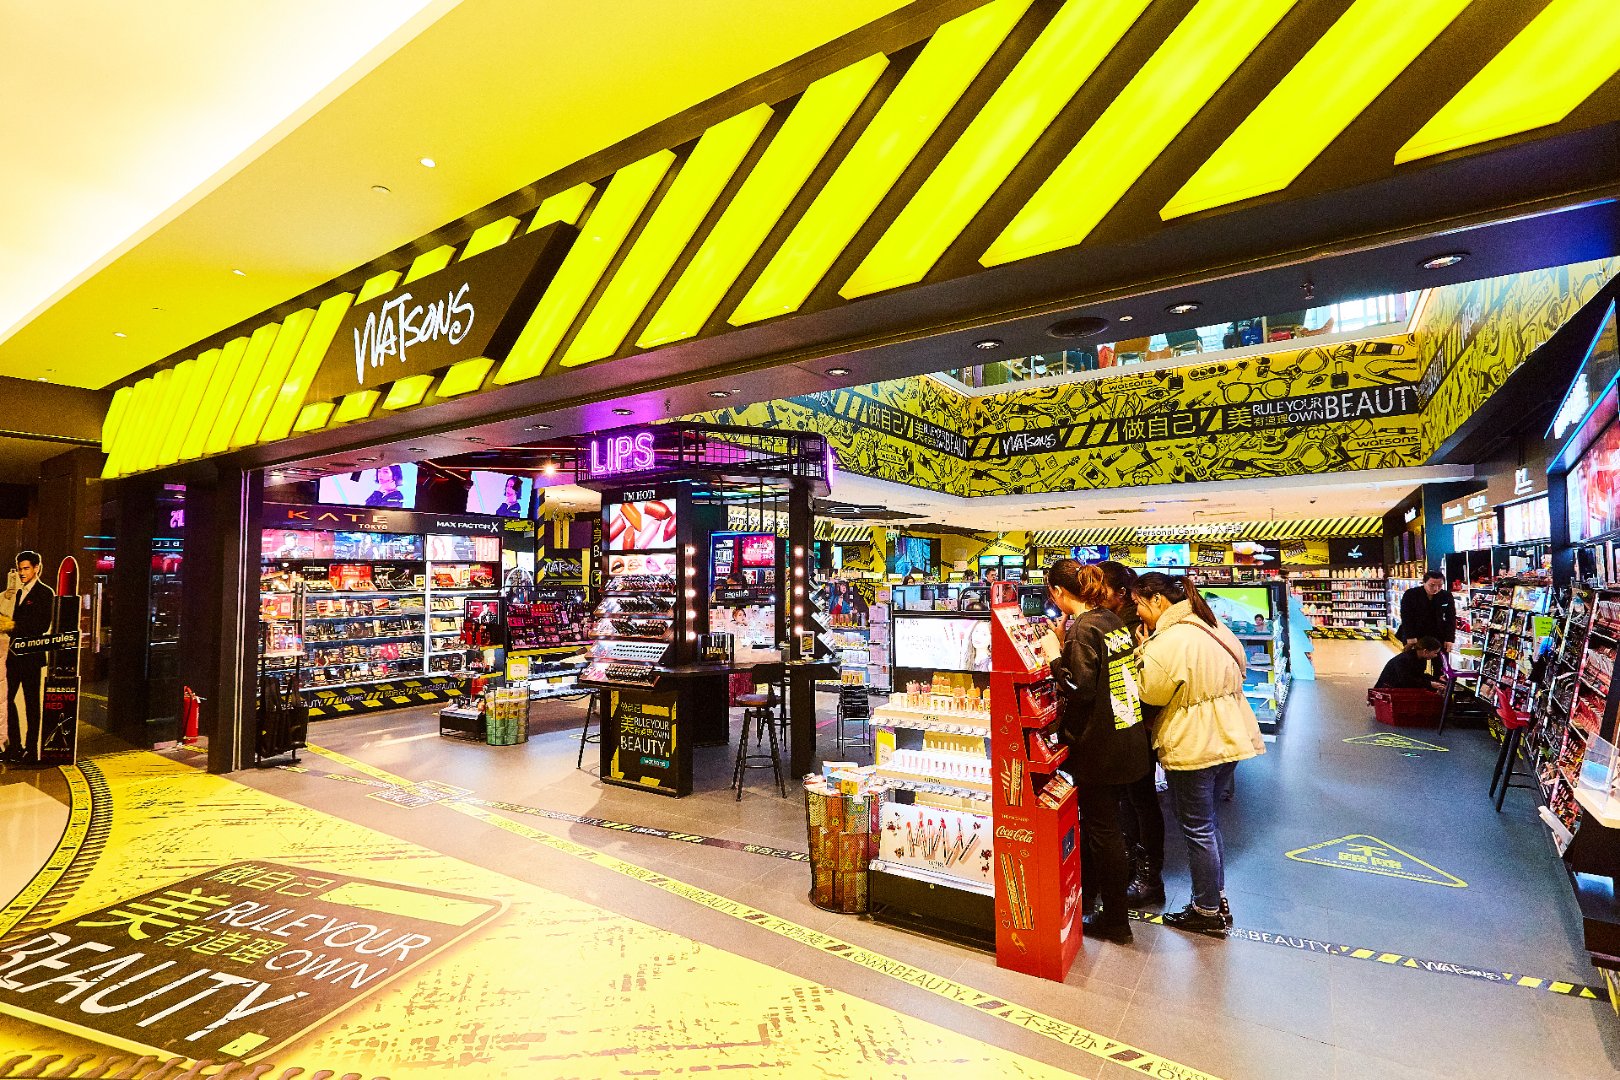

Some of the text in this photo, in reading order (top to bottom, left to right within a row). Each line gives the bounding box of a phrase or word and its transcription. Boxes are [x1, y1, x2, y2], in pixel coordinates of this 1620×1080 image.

[1108, 379, 1154, 391] watsons
[1252, 397, 1323, 416] RULE YOUR
[1227, 407, 1252, 430] 美
[1288, 409, 1324, 424] OWN
[1122, 413, 1197, 441] 做自己
[1357, 435, 1418, 447] watsons
[591, 432, 655, 474] LIPS
[287, 510, 389, 524] KATE
[436, 520, 456, 529] MAX
[14, 640, 26, 649] no
[27, 637, 50, 648] more
[51, 633, 77, 645] rules.
[44, 702, 65, 710] RED
[45, 692, 76, 702] TOKYO
[620, 714, 635, 734] 美
[650, 719, 670, 731] YOUR
[995, 825, 1035, 843] Coca-Cola
[204, 863, 336, 897] 做自己
[74, 888, 231, 940] 美
[203, 900, 432, 962] RULE YOUR
[153, 925, 288, 964] 有道理
[264, 949, 388, 990] OWN
